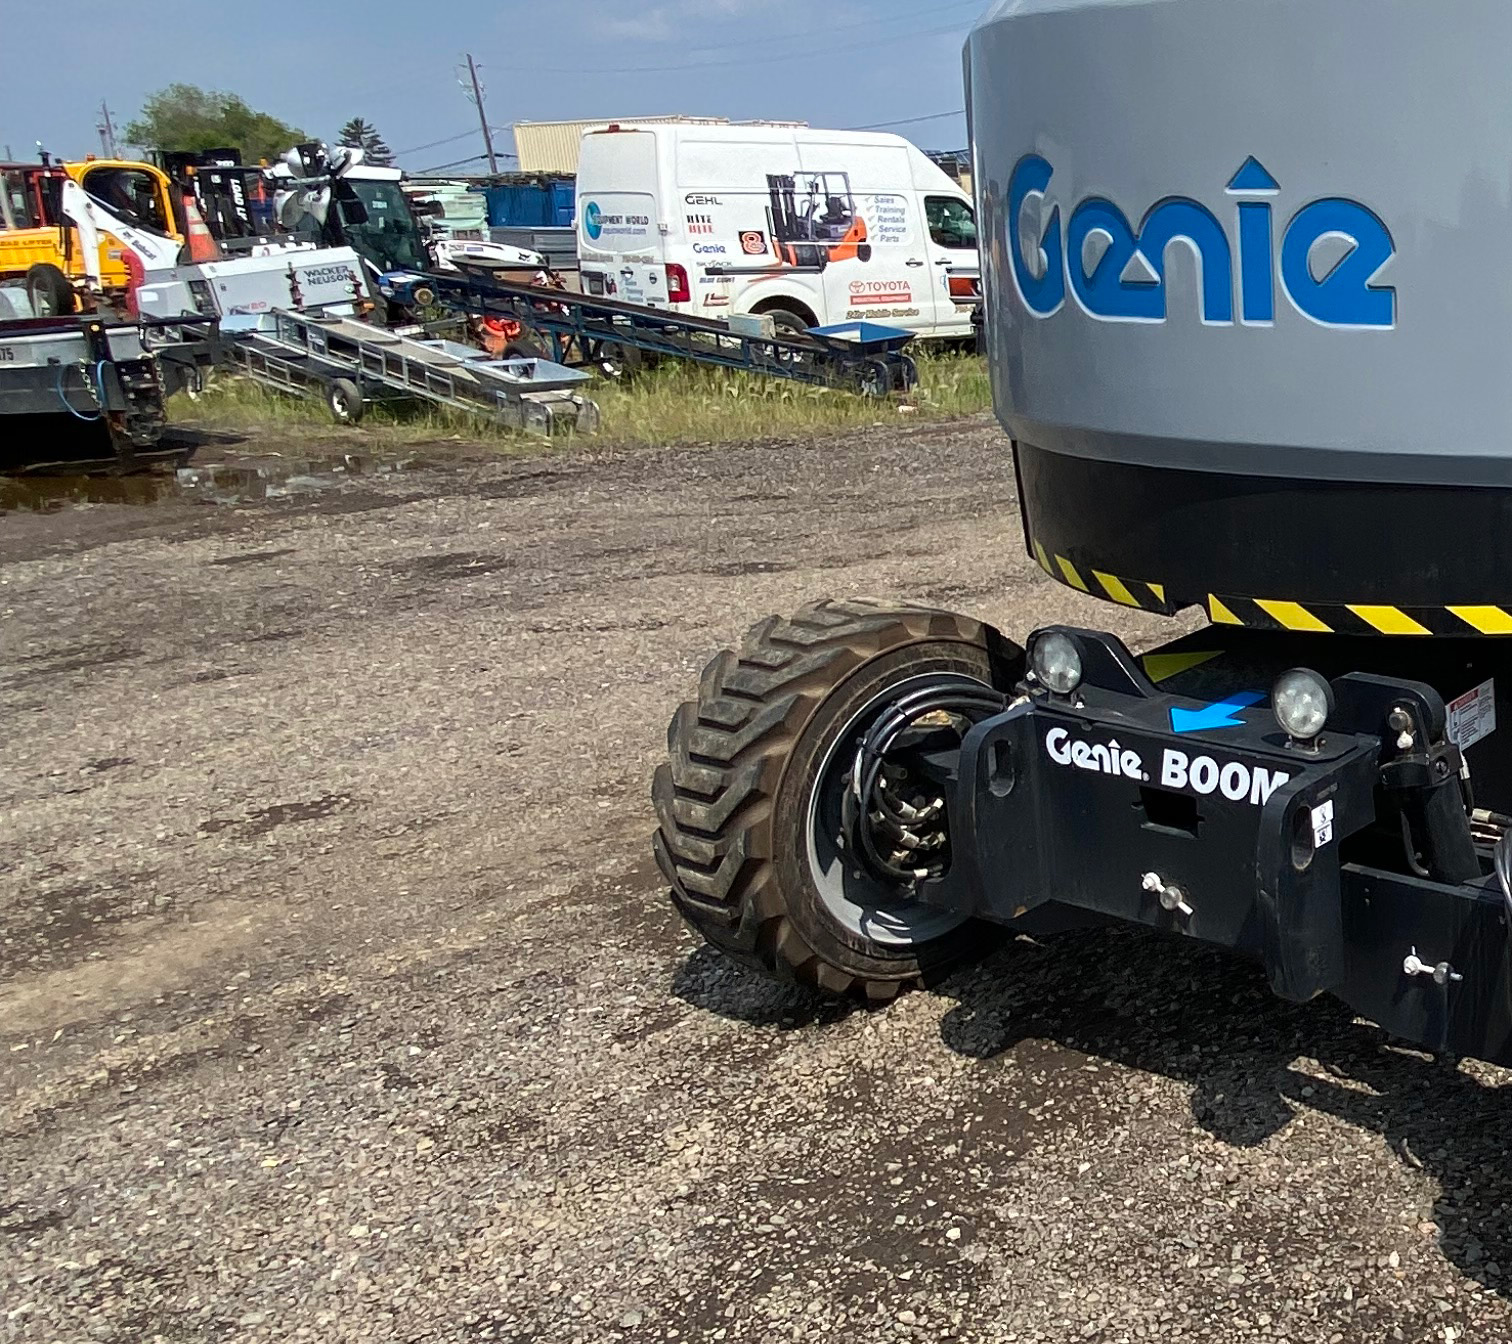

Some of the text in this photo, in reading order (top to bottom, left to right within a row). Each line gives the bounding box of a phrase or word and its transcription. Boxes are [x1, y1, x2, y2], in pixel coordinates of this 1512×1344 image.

[685, 195, 723, 205] GEHL
[692, 242, 726, 253] Genie
[1008, 153, 1396, 330] Genie
[303, 265, 350, 278] WACKER
[307, 271, 351, 286] NEUSON
[866, 280, 911, 292] TOYOTA
[1045, 727, 1290, 807] Genie BOOM
